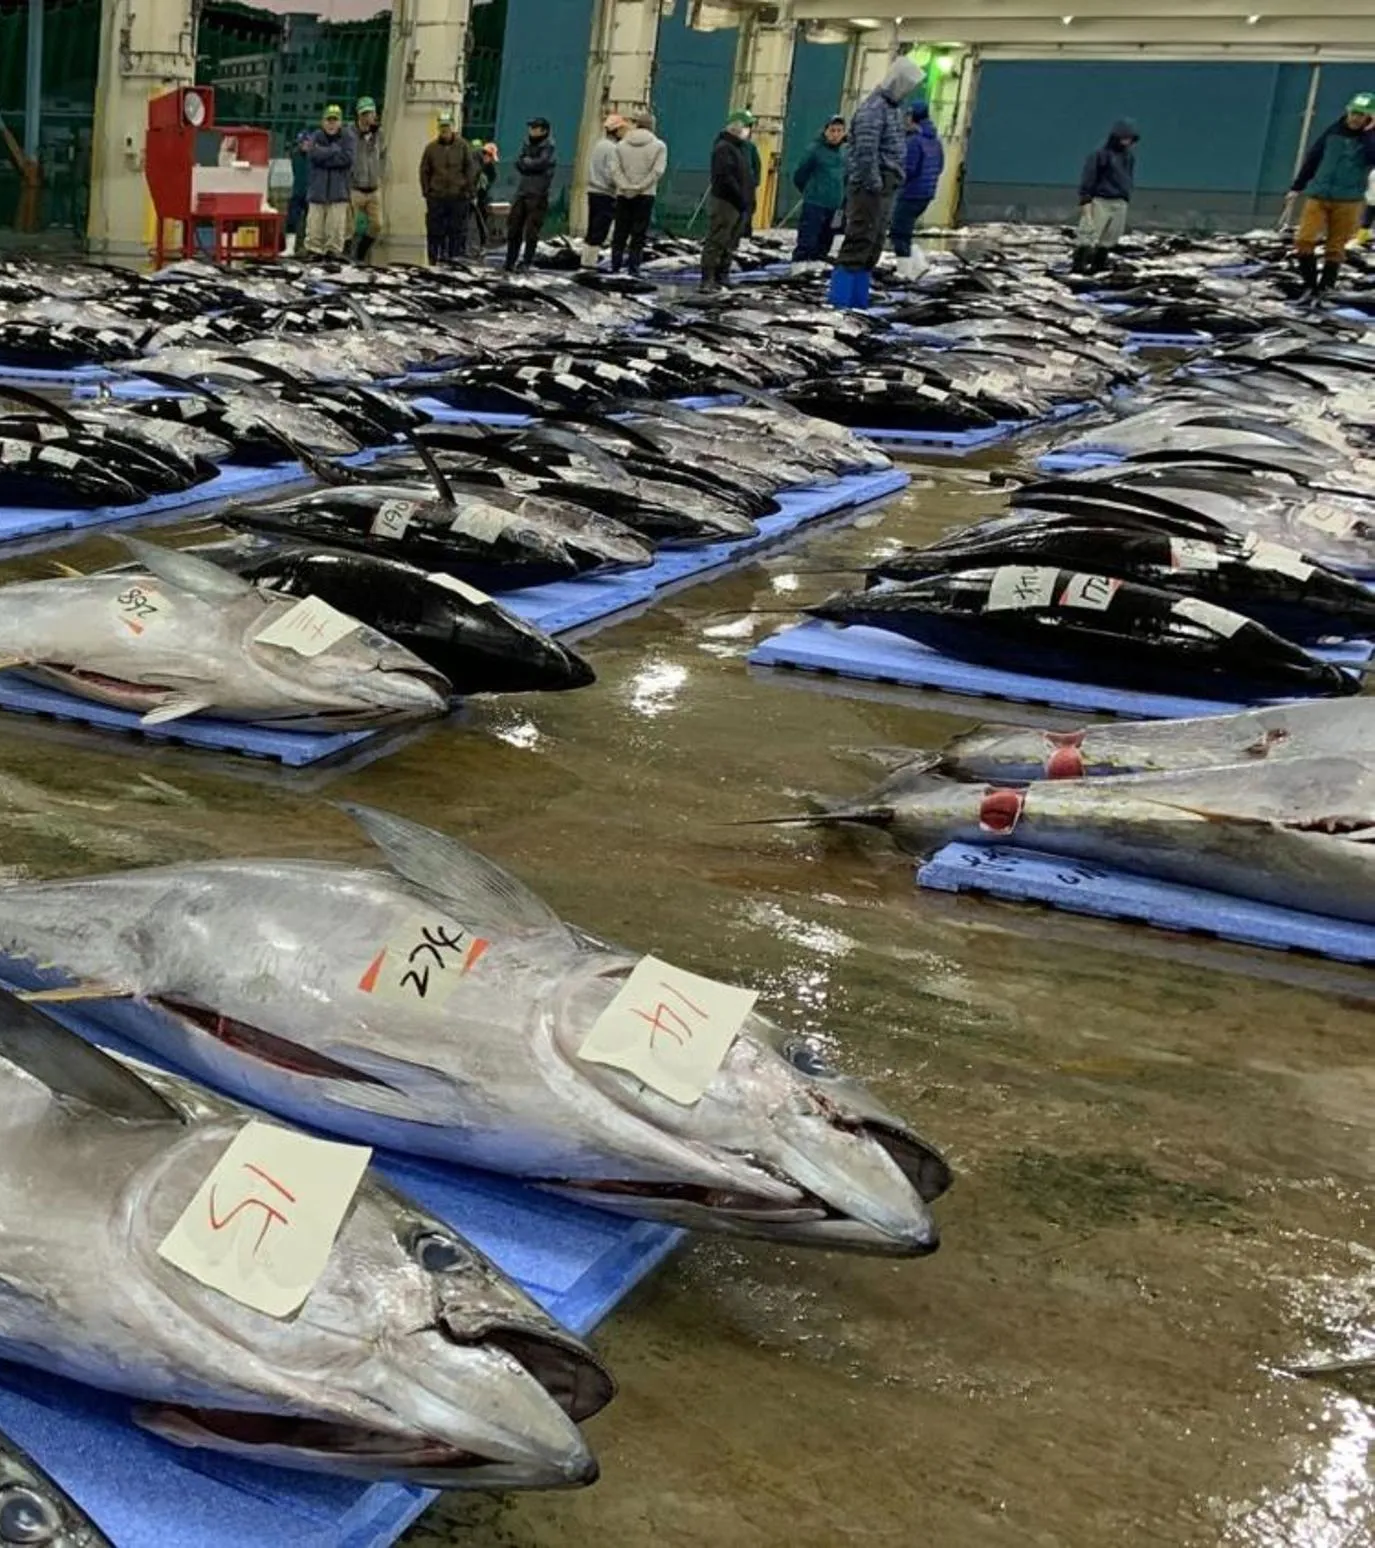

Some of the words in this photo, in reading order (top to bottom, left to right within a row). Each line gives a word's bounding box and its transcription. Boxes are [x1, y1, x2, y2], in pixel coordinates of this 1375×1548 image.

[382, 501, 410, 531] 190
[399, 925, 464, 998] 274
[630, 982, 708, 1048] 14
[209, 1162, 296, 1254] 15
